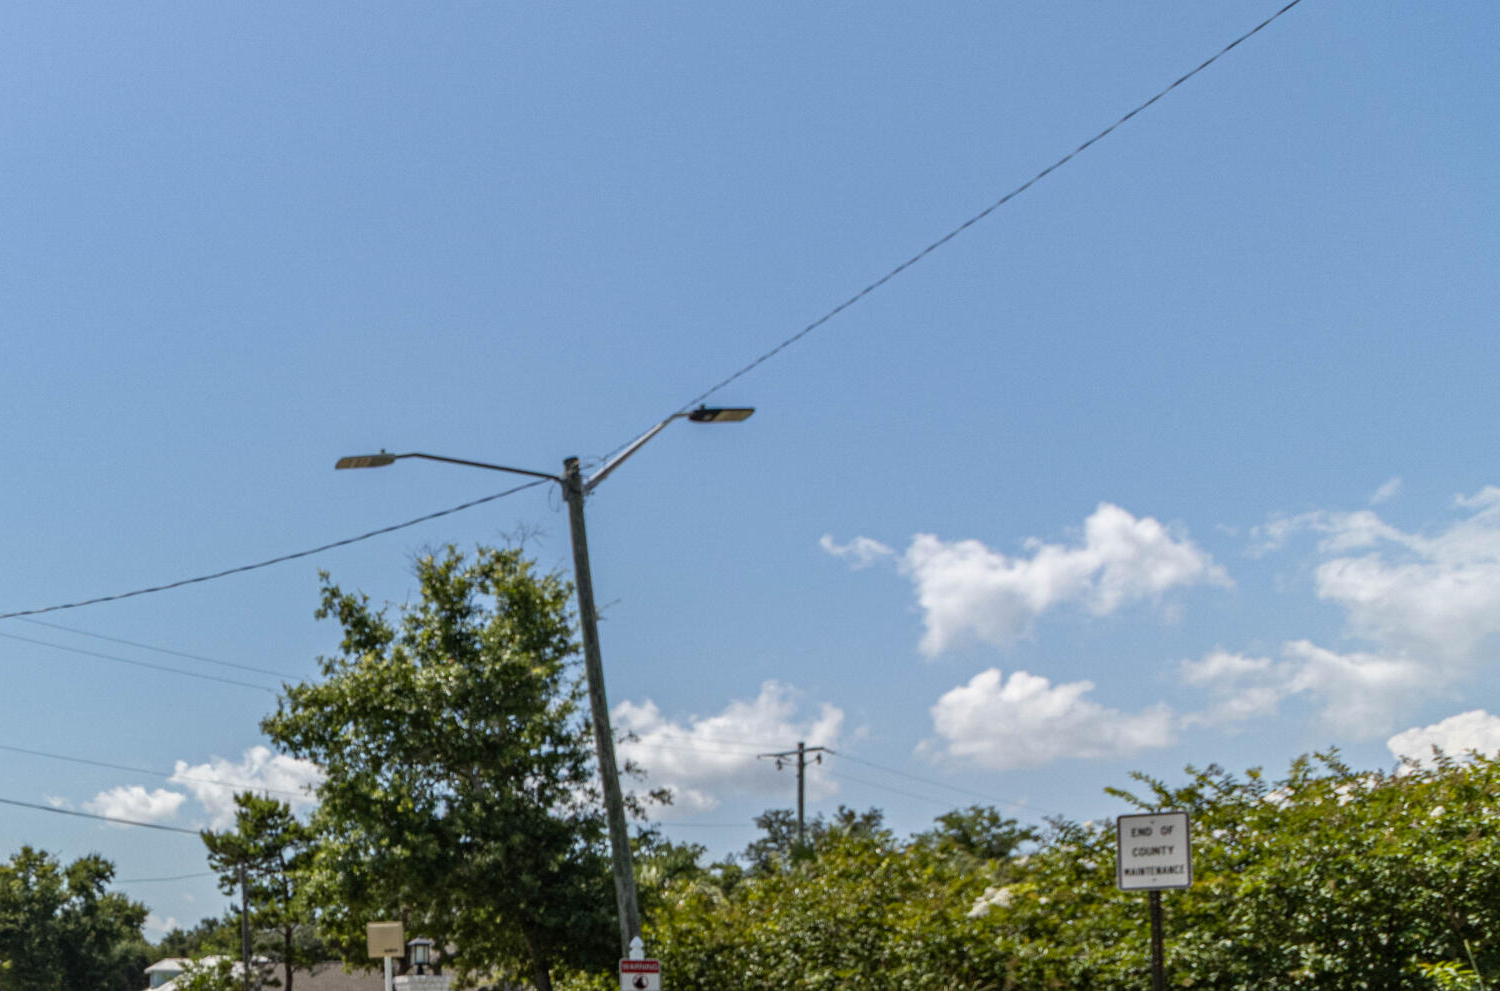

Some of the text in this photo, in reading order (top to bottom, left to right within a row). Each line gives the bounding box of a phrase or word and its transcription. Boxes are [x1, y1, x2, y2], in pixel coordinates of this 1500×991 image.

[1131, 825, 1174, 838] END OF
[1131, 845, 1174, 858] COUNTY
[1124, 864, 1185, 876] MAINTENANCE
